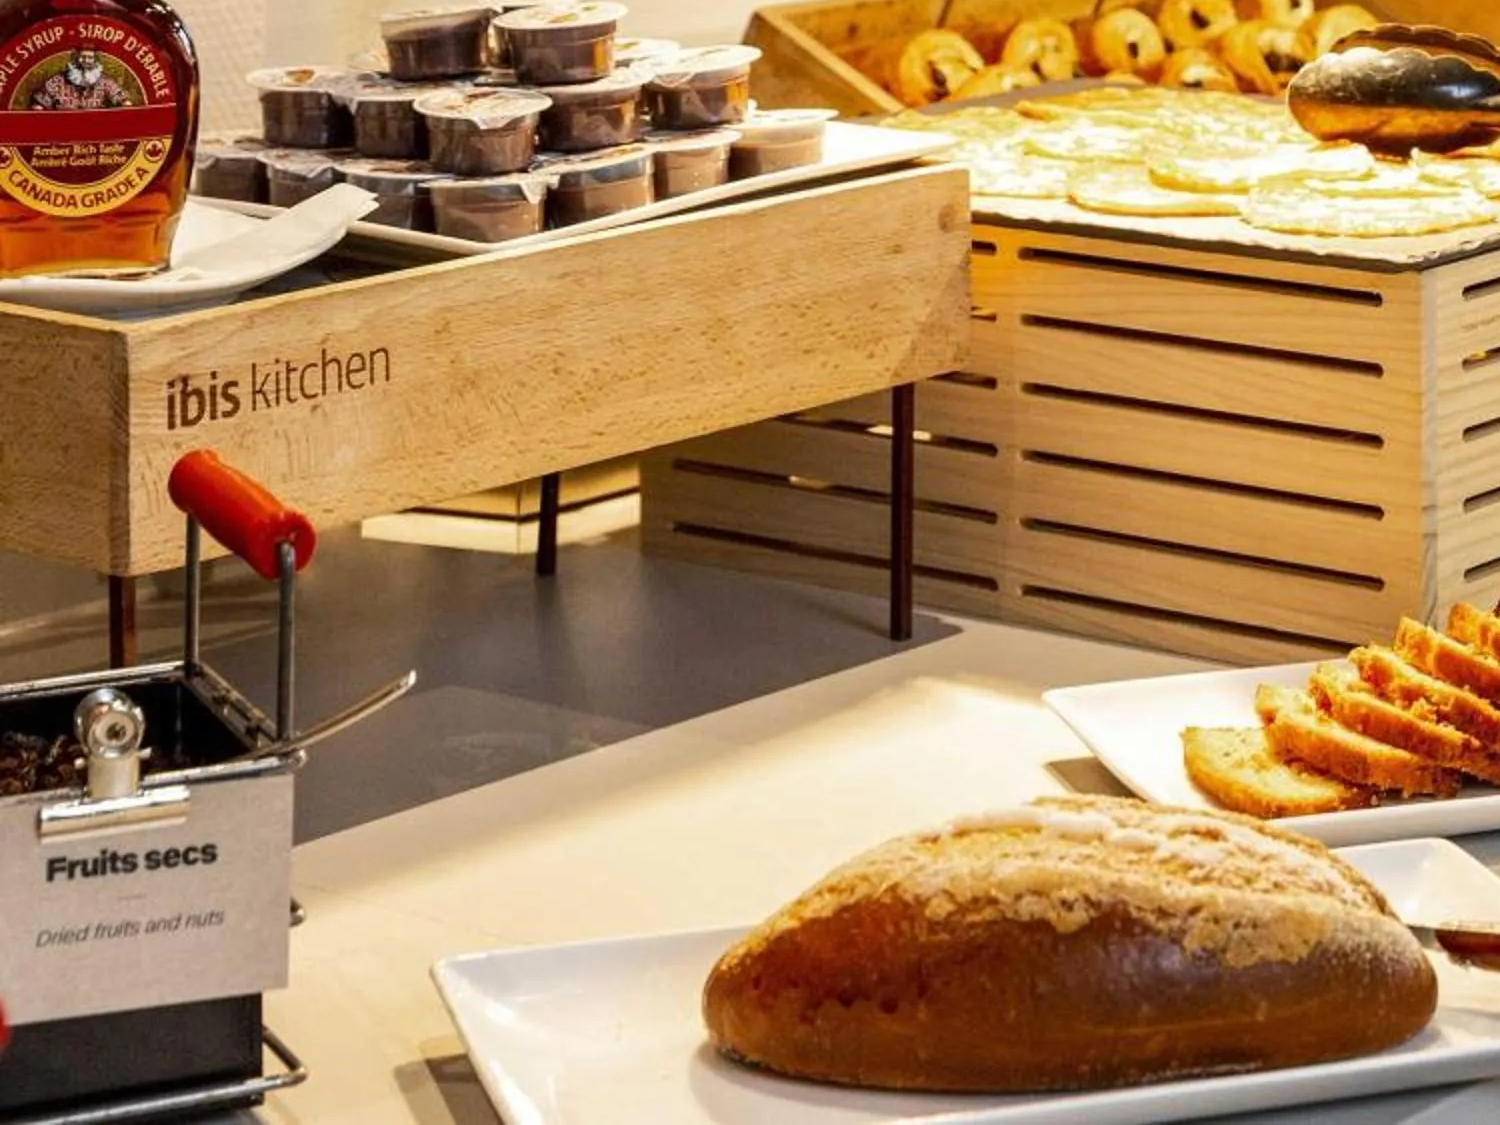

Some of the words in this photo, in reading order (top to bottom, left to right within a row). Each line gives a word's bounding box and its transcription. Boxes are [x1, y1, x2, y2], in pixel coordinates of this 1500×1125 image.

[15, 26, 64, 59] SYRUP
[78, 22, 125, 44] SIROP
[8, 170, 78, 209] CANADA
[80, 176, 136, 209] GRADE
[135, 166, 149, 182] A
[166, 370, 242, 431] ibis
[251, 346, 390, 412] kitchen
[46, 848, 139, 882] Fruits
[144, 843, 218, 871] secs
[35, 922, 90, 948] Dried
[93, 918, 140, 941] fruits
[144, 912, 183, 935] and
[185, 909, 225, 931] nuts
